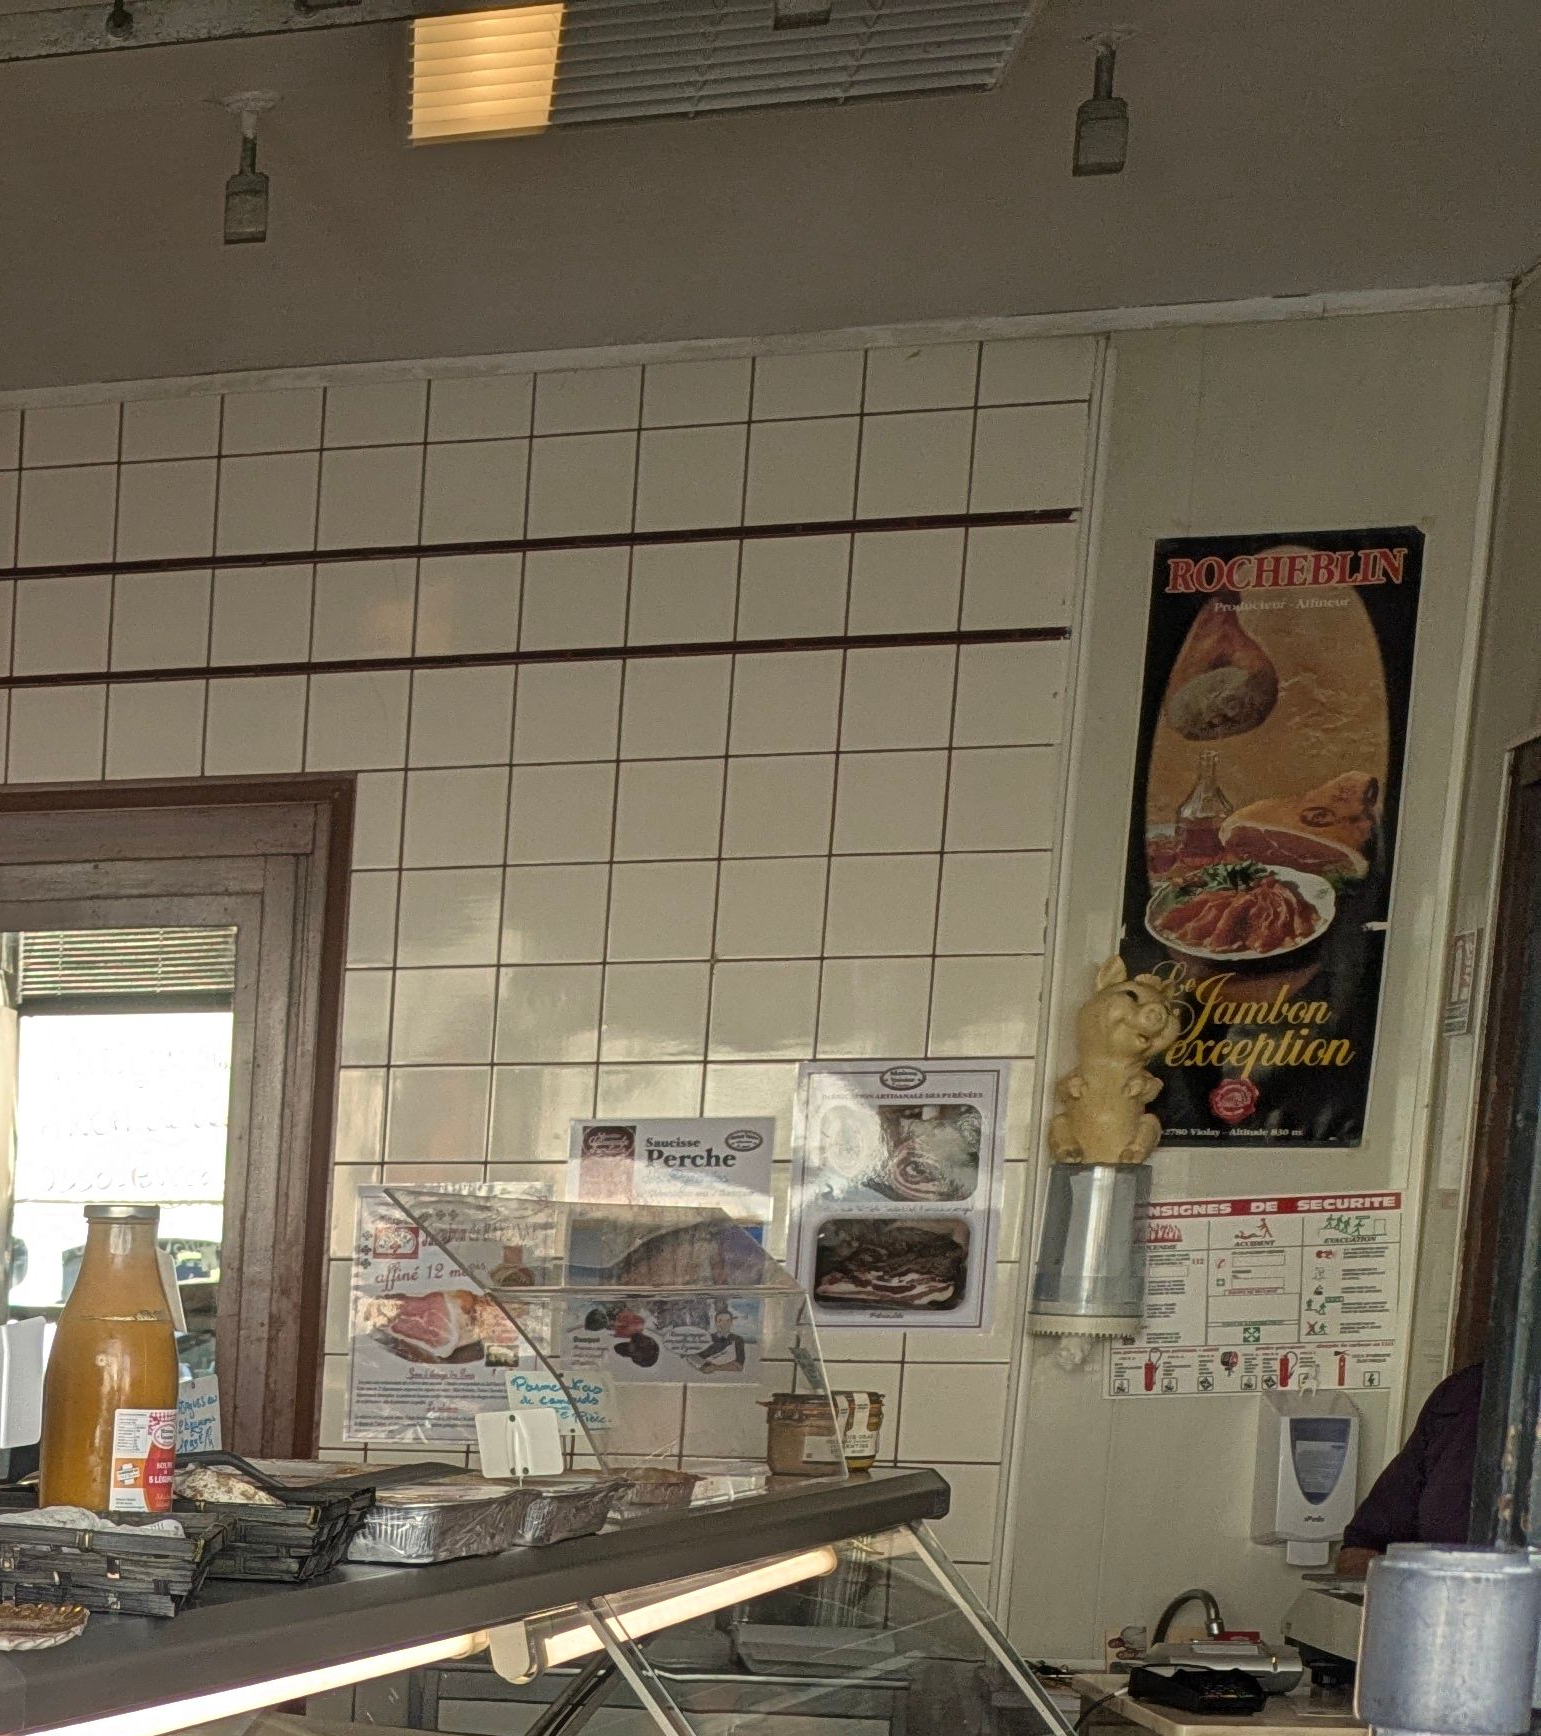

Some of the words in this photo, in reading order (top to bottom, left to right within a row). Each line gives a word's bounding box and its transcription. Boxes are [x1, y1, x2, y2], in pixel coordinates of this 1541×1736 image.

[1165, 548, 1408, 593] ROCHEBLIN
[1214, 600, 1287, 613] Producteur
[1295, 597, 1351, 610] Affineur
[1167, 972, 1331, 1044] Jambon
[645, 1136, 701, 1149] Saucisse
[1161, 1128, 1188, 1137] 2780
[645, 1147, 738, 1169] Perche
[1148, 1203, 1232, 1217] NSIGNES
[1250, 1200, 1278, 1213] DE
[1297, 1196, 1397, 1211] SECURITE
[374, 1261, 421, 1292] affiné
[427, 1263, 445, 1279] 12
